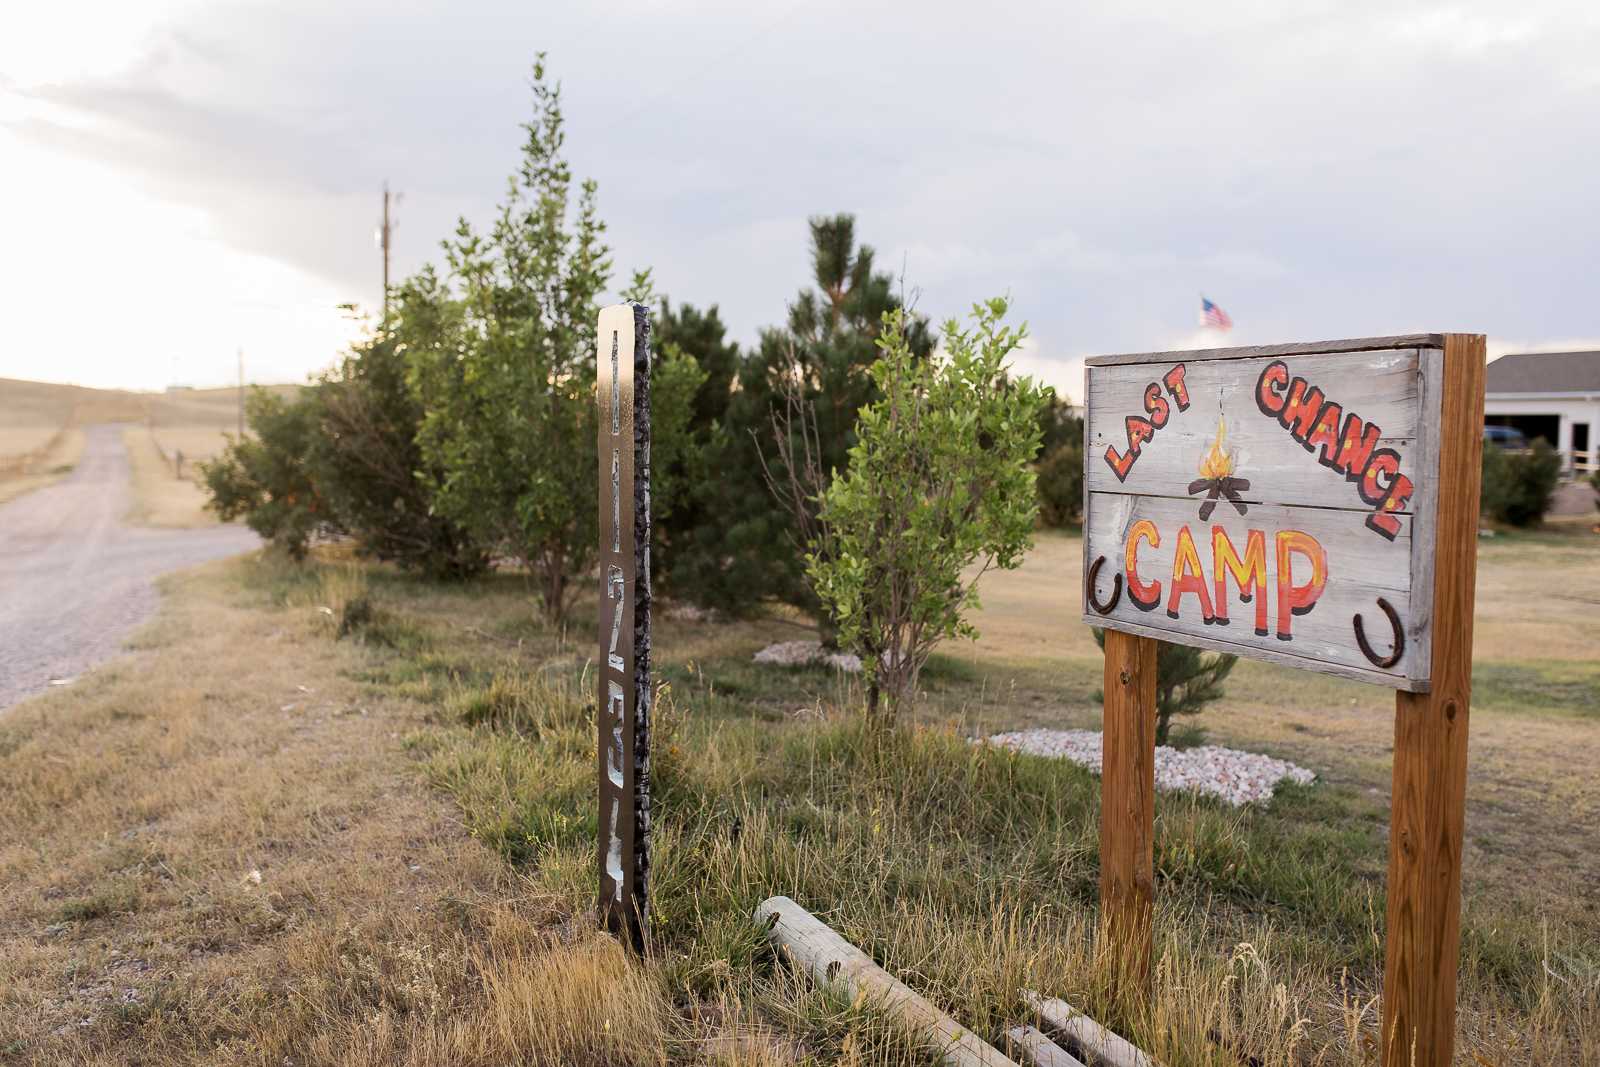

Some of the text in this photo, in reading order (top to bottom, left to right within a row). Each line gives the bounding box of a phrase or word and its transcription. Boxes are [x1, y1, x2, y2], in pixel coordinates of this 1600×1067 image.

[1104, 360, 1414, 542] LAST CHANCE
[606, 330, 625, 903] 11234
[1124, 520, 1328, 641] CAMP
